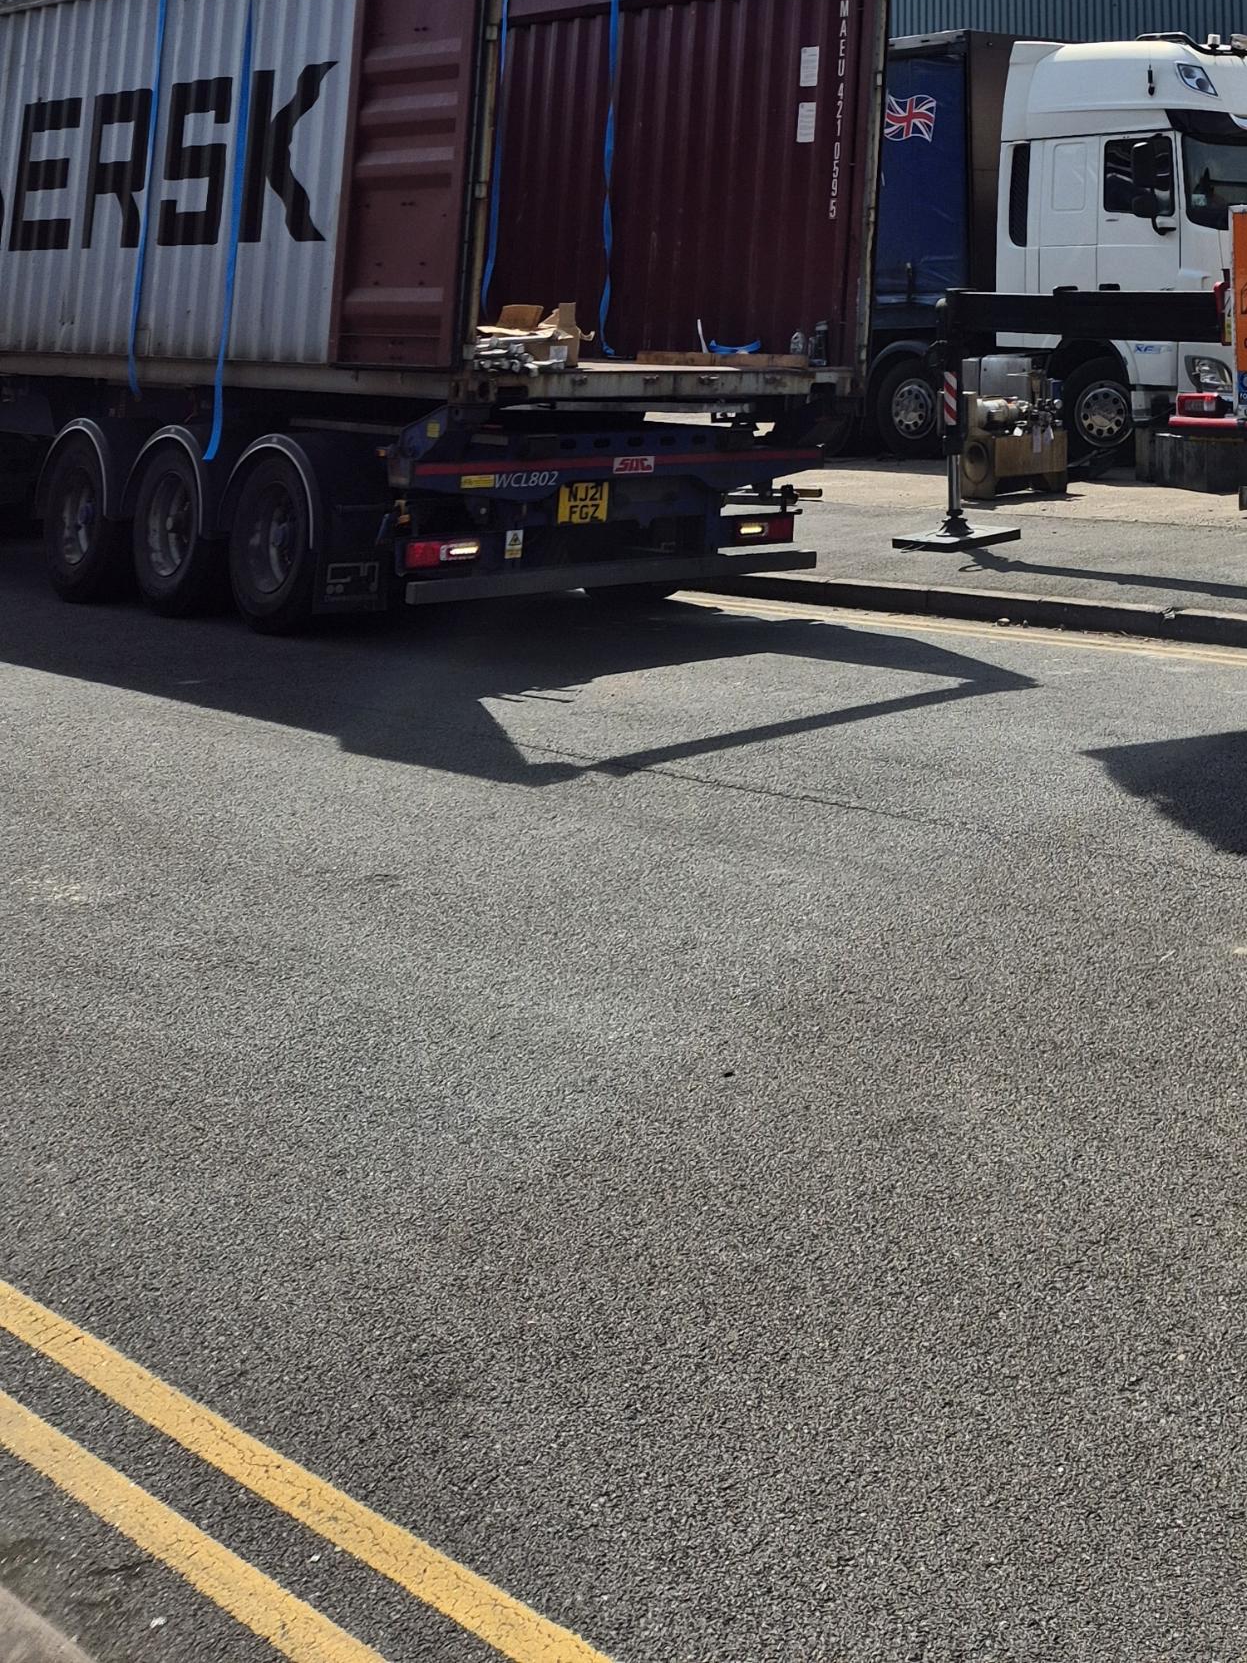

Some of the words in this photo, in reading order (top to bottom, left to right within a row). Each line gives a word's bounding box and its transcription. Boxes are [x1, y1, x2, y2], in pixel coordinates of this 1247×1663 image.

[837, 0, 849, 77] MAEU
[0, 61, 339, 252] ERSK
[494, 471, 559, 488] WCL802
[569, 504, 600, 521] FGZ
